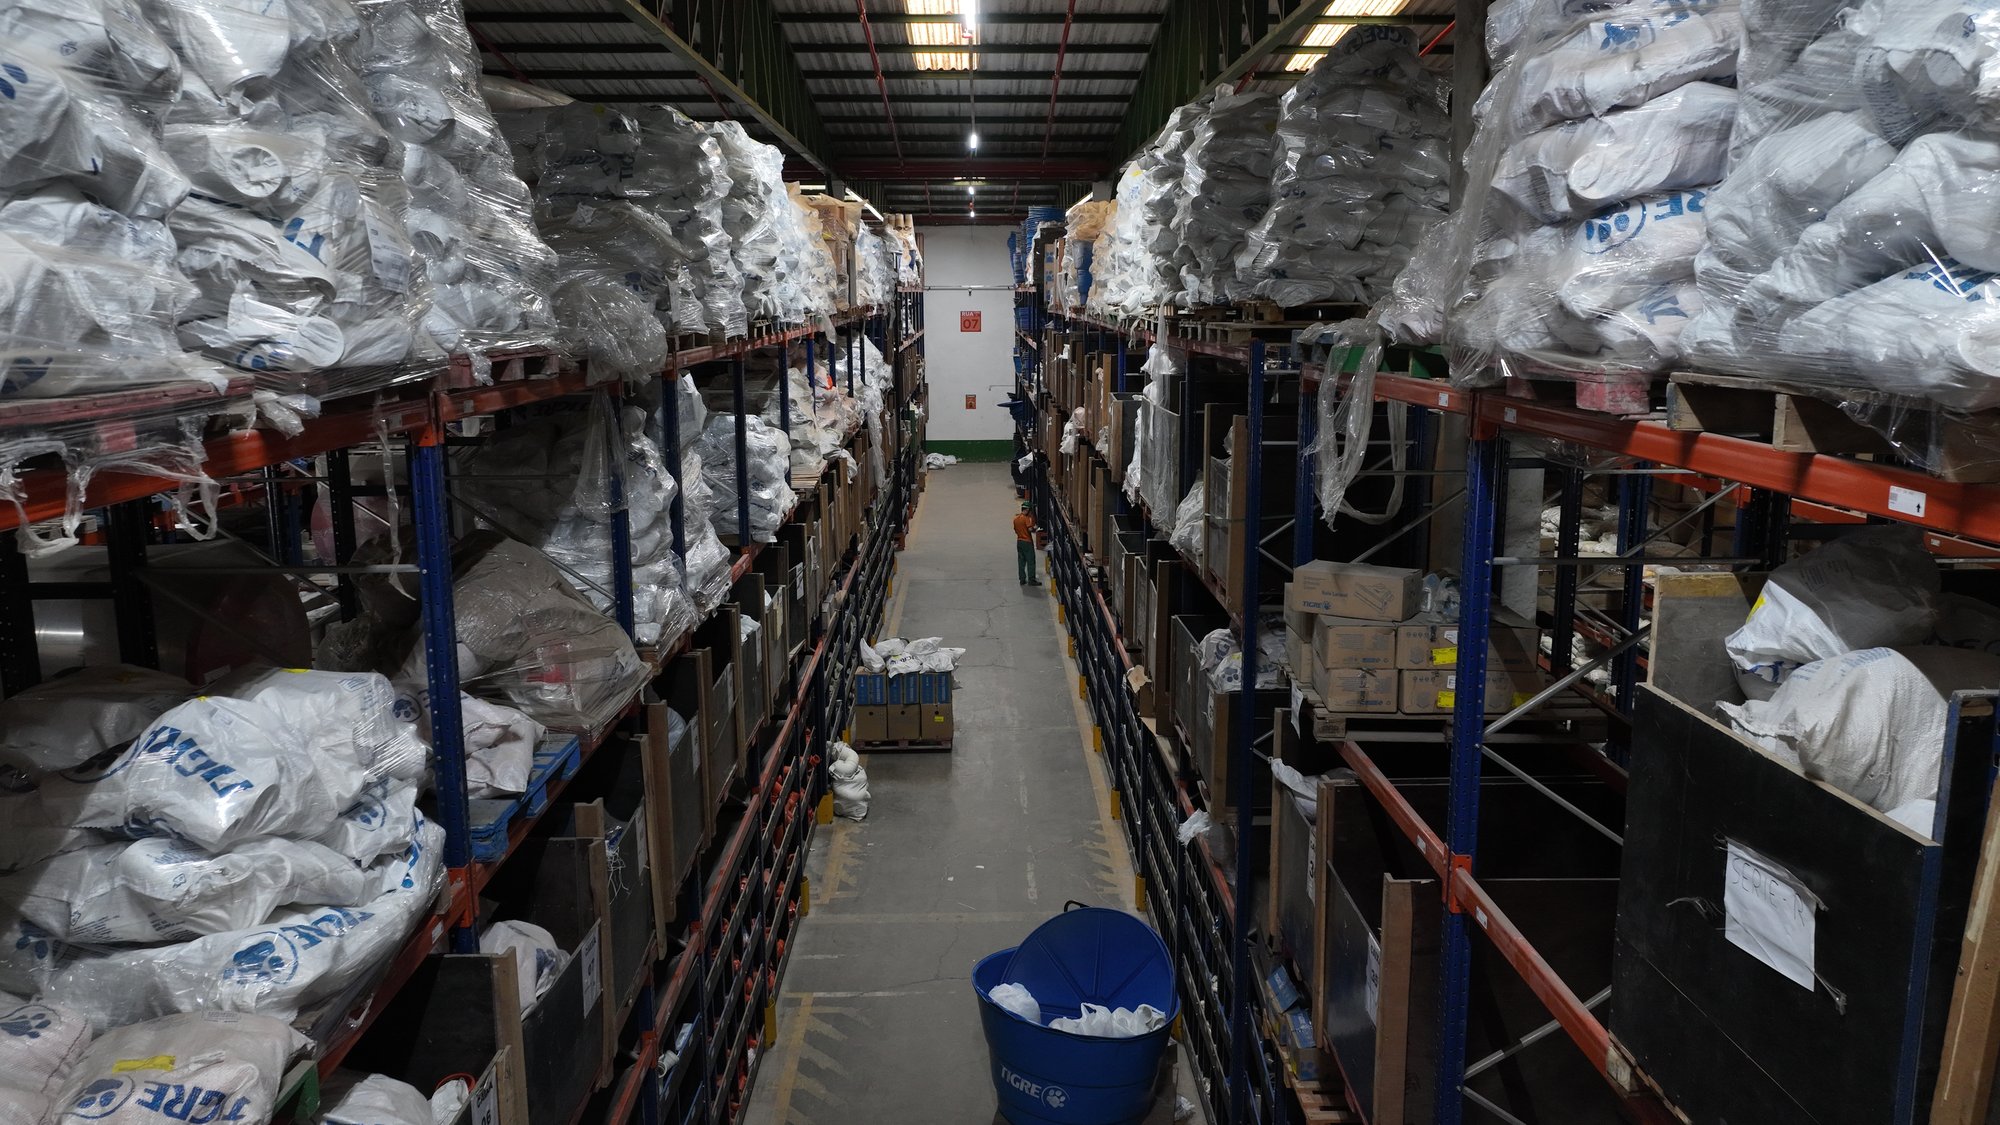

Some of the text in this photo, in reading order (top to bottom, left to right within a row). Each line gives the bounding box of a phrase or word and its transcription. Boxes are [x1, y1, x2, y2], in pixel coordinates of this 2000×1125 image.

[963, 319, 979, 330] 07
[1302, 600, 1321, 609] TIGRE
[1001, 1064, 1042, 1100] TIGRE
[135, 1080, 252, 1125] TGRE
